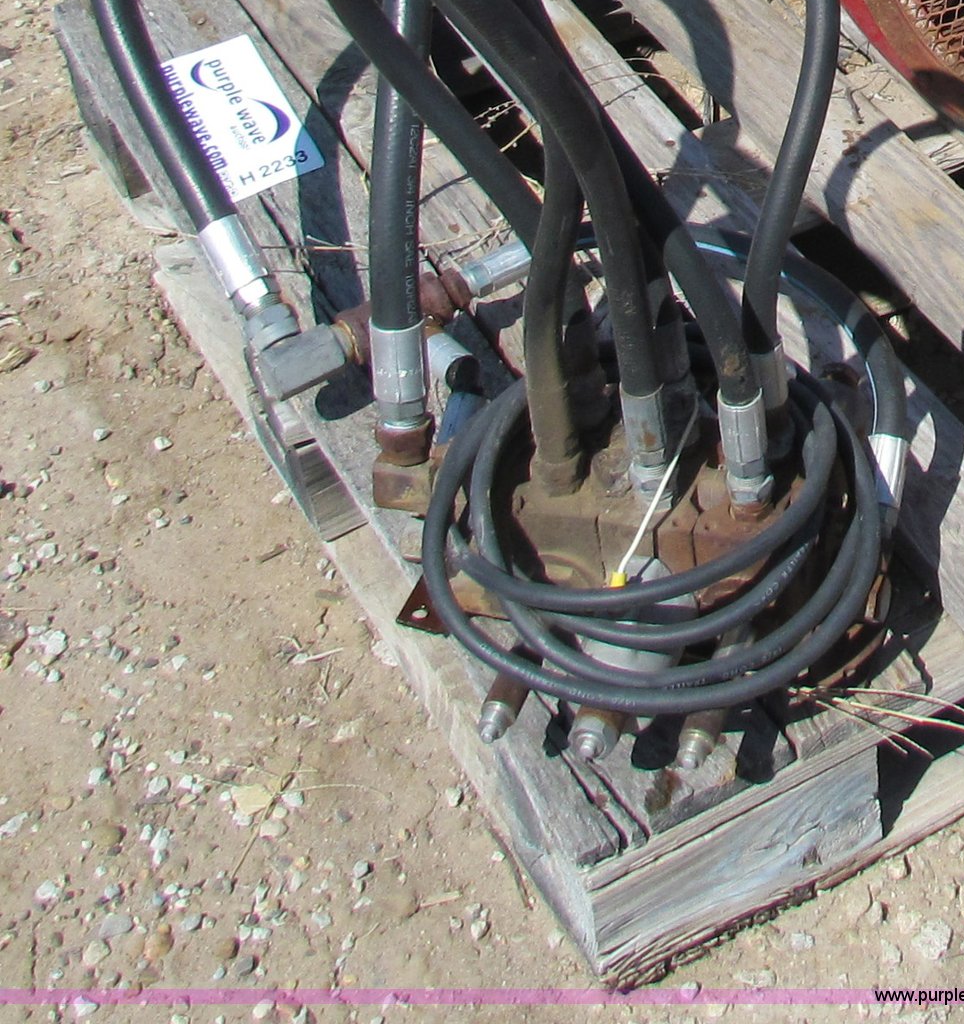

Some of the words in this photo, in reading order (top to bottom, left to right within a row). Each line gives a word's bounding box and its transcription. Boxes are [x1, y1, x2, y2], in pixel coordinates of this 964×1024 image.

[204, 59, 243, 106] purple
[236, 108, 267, 144] wave
[239, 171, 256, 186] H
[259, 150, 309, 179] 2233
